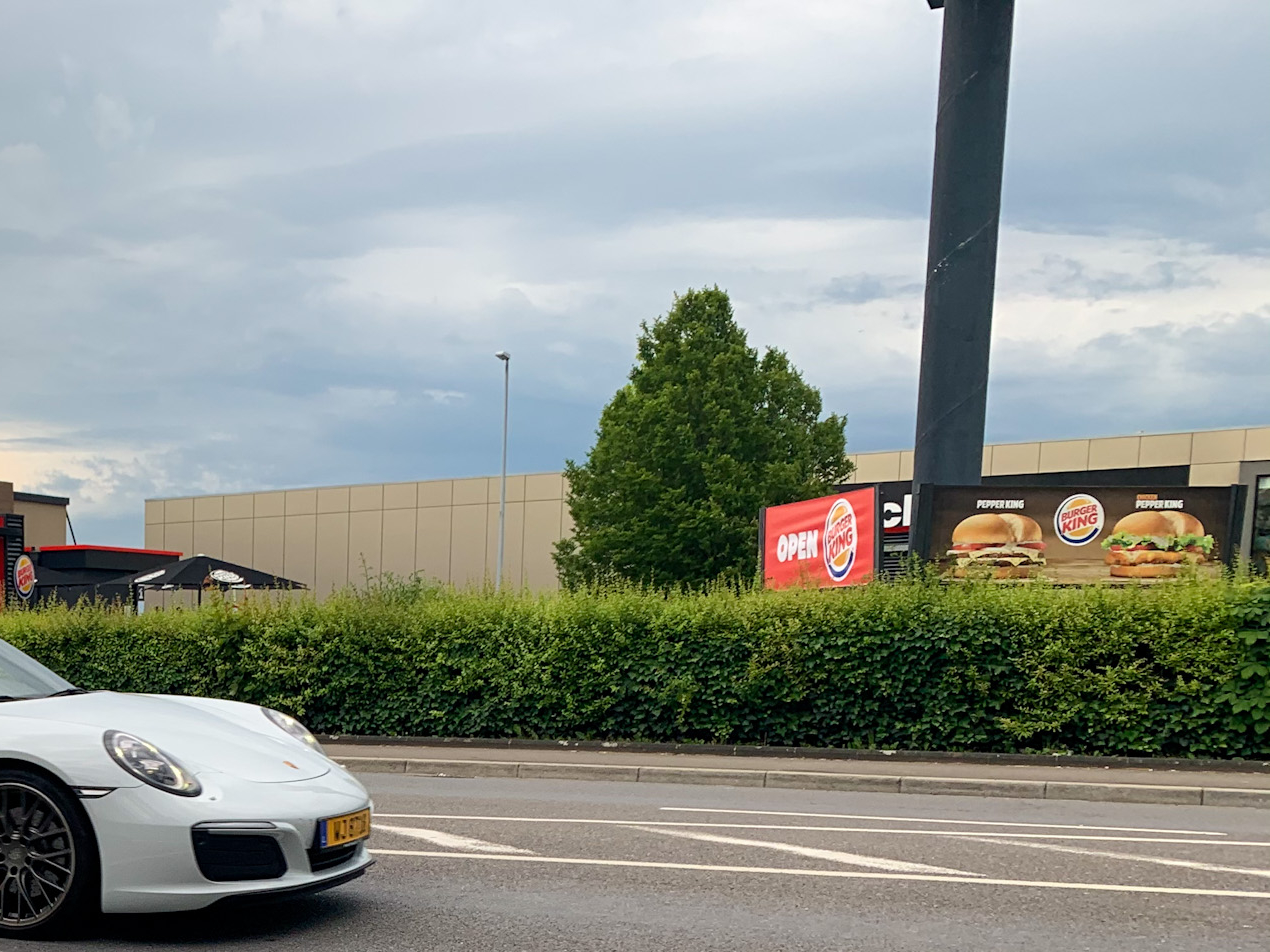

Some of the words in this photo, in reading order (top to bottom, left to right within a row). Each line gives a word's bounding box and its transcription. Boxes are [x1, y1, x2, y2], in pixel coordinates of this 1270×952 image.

[976, 500, 1005, 509] PEPPER
[1005, 500, 1025, 509] KING
[1061, 504, 1097, 522] BURGER
[1135, 500, 1164, 509] PEPPER
[1164, 500, 1183, 509] KING
[828, 513, 852, 543] BURGER
[1062, 513, 1098, 533] KING
[777, 529, 819, 562] OPEN
[829, 527, 853, 558] KING
